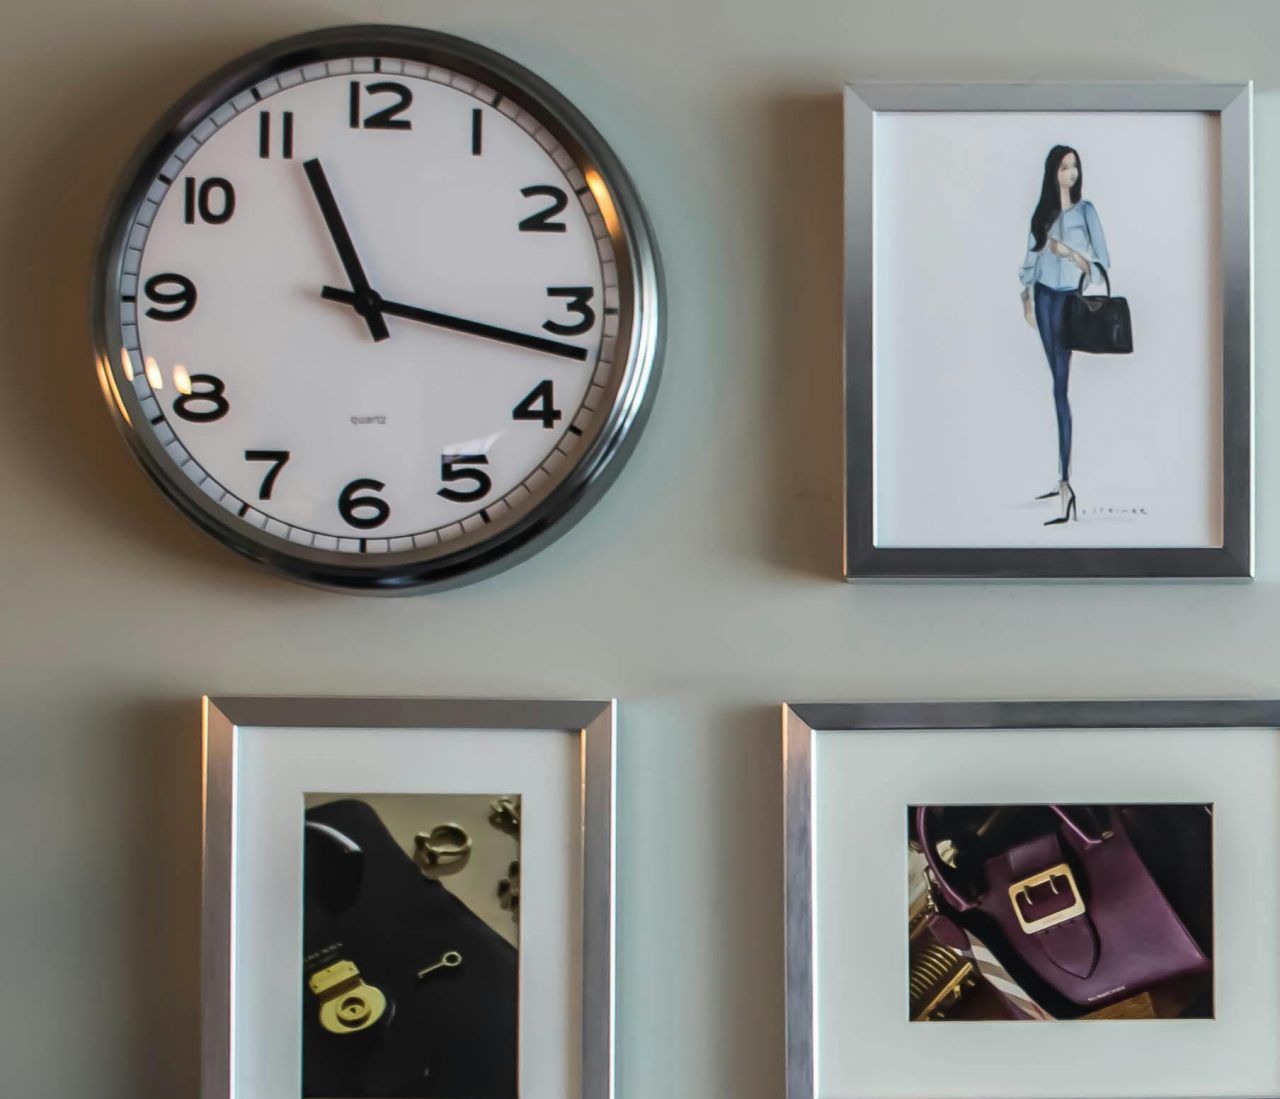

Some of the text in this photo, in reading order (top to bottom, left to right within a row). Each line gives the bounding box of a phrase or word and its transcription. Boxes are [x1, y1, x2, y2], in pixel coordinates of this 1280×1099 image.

[350, 81, 414, 130] 12
[259, 110, 294, 159] 11
[472, 108, 482, 156] 1
[184, 177, 236, 225] 10
[518, 185, 569, 233] 2
[144, 273, 197, 322] 9
[542, 286, 596, 336] 3
[173, 374, 230, 423] 8
[349, 414, 388, 427] quartz
[512, 379, 562, 429] 4
[244, 450, 290, 500] 7
[436, 454, 493, 503] 5
[338, 479, 391, 530] 6
